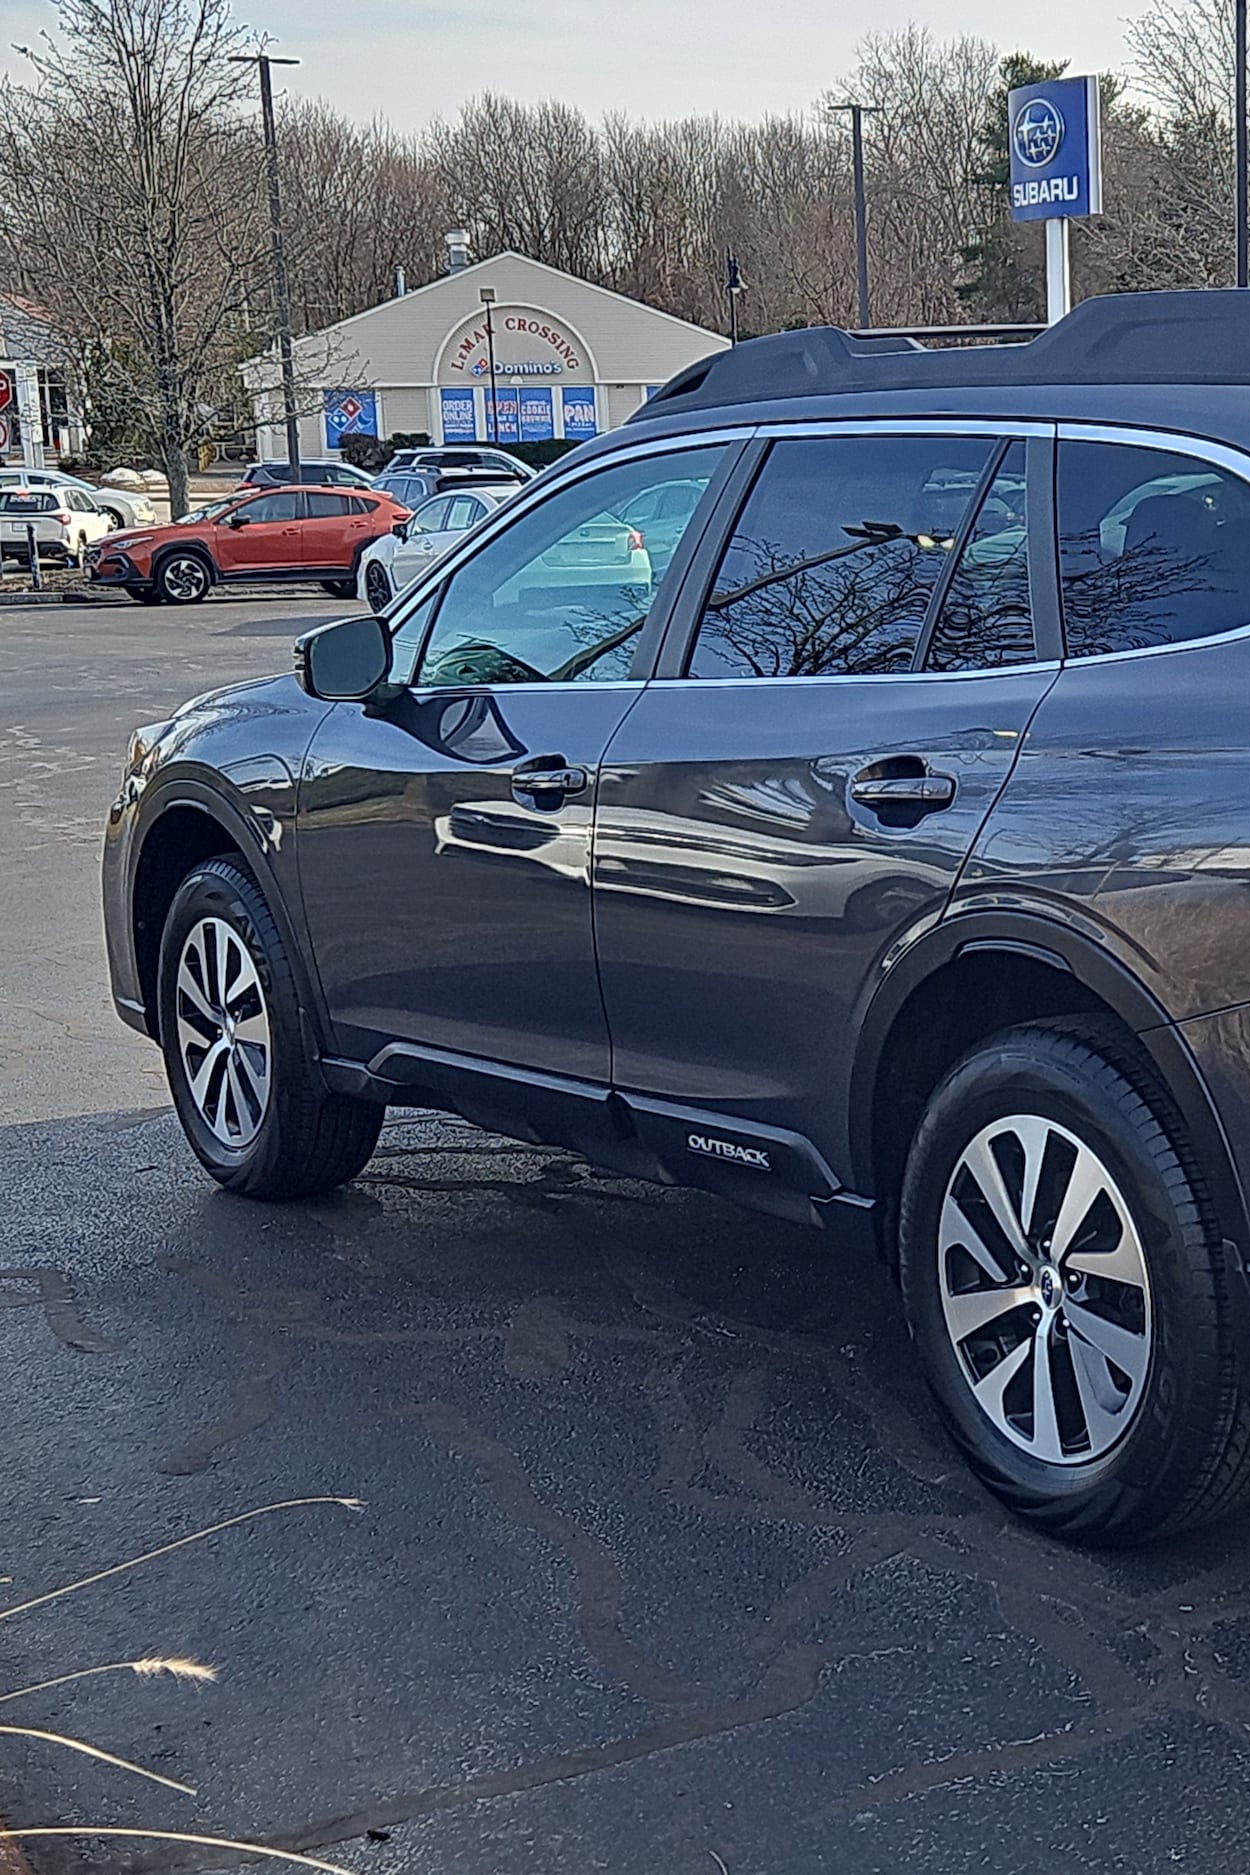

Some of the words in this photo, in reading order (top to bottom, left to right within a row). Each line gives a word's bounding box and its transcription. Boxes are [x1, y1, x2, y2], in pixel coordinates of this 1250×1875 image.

[1013, 175, 1078, 208] SUBARU
[505, 317, 580, 370] CROSSING
[494, 360, 563, 375] Domino's
[443, 400, 473, 410] ORDER
[521, 405, 551, 414] COOKIE
[564, 404, 595, 423] PAN
[443, 410, 473, 421] ONLINE
[687, 1134, 770, 1168] OUTBACK
